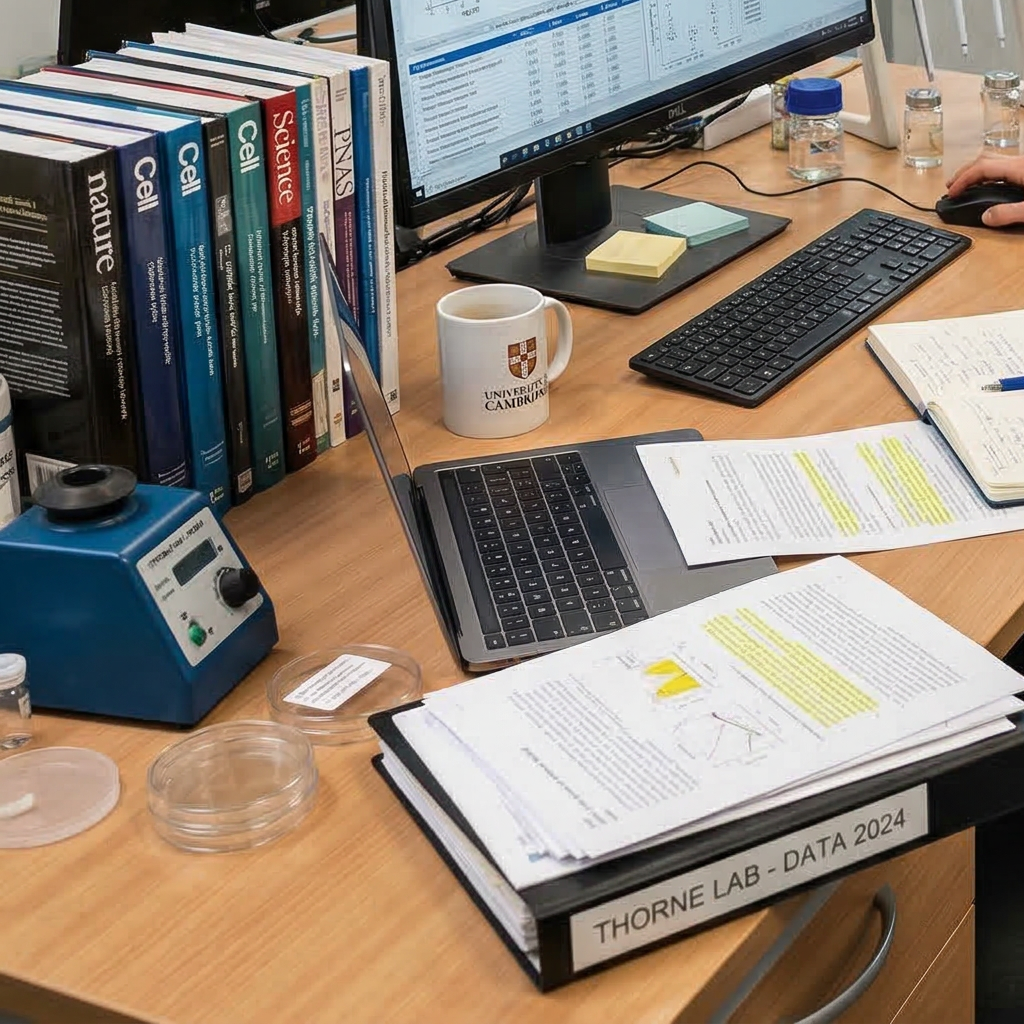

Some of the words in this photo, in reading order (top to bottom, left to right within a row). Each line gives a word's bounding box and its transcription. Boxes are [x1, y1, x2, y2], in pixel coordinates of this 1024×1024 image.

[178, 141, 202, 198] Cell
[237, 119, 261, 175] Cell
[272, 110, 297, 206] Science
[333, 125, 354, 197] PNAS
[133, 156, 160, 214] Cell
[87, 170, 115, 275] nature
[592, 884, 705, 944] THORNE
[712, 863, 761, 900] LAB
[783, 831, 847, 873] DATA
[853, 807, 906, 847] 2024
